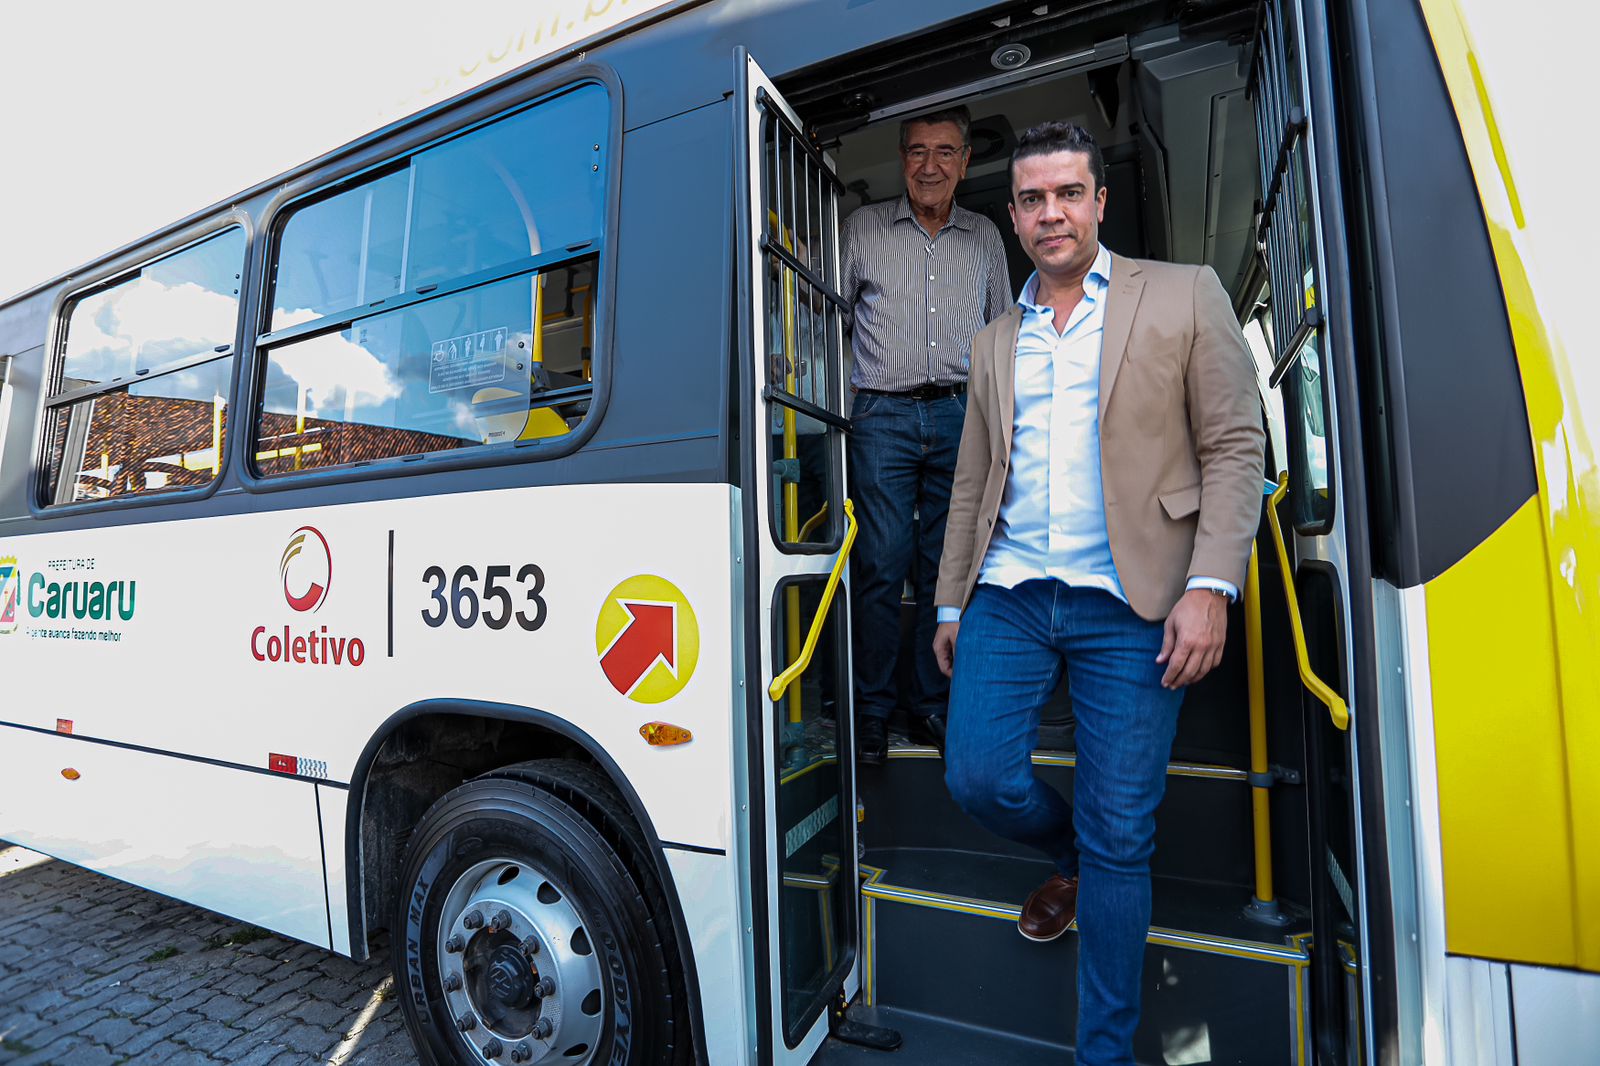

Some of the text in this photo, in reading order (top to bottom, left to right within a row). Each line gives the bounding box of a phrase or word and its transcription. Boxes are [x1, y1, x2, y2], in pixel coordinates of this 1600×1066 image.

[47, 558, 95, 571] PREFEITURA DE
[27, 572, 136, 621] Caruaru
[420, 563, 548, 632] 3653
[71, 627, 97, 641] fazendo
[98, 629, 122, 642] melhor
[250, 625, 366, 667] Coletivo
[407, 876, 431, 1025] URBAN MAX
